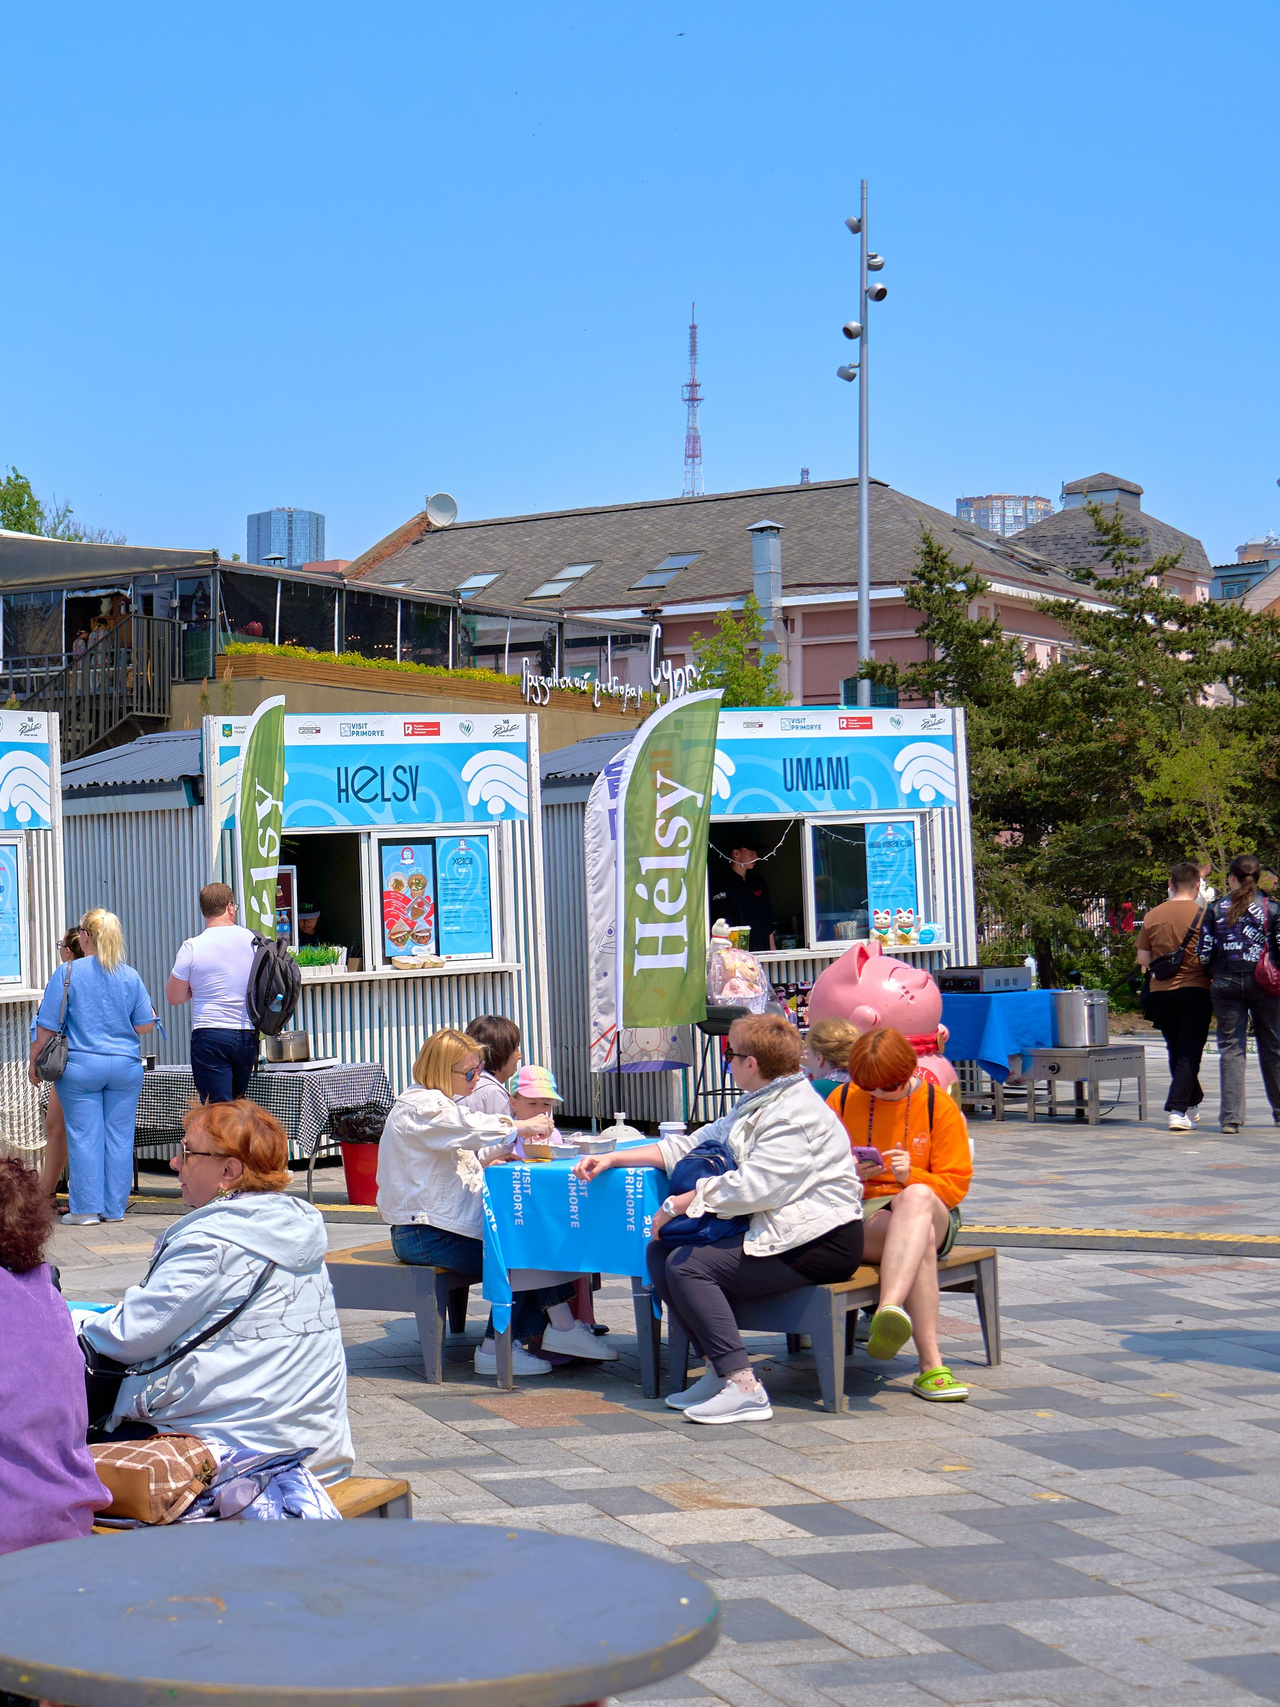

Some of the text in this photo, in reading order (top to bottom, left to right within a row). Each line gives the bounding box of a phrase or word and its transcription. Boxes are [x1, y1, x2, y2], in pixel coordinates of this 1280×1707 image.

[783, 756, 850, 792] UMAMI
[633, 770, 705, 977] Hélsy
[1223, 941, 1243, 951] WOW
[511, 1166, 524, 1226] PRIMORYE
[521, 1166, 531, 1196] VISIT
[578, 1178, 588, 1198] SIT
[625, 1168, 636, 1232] PRIMORYE
